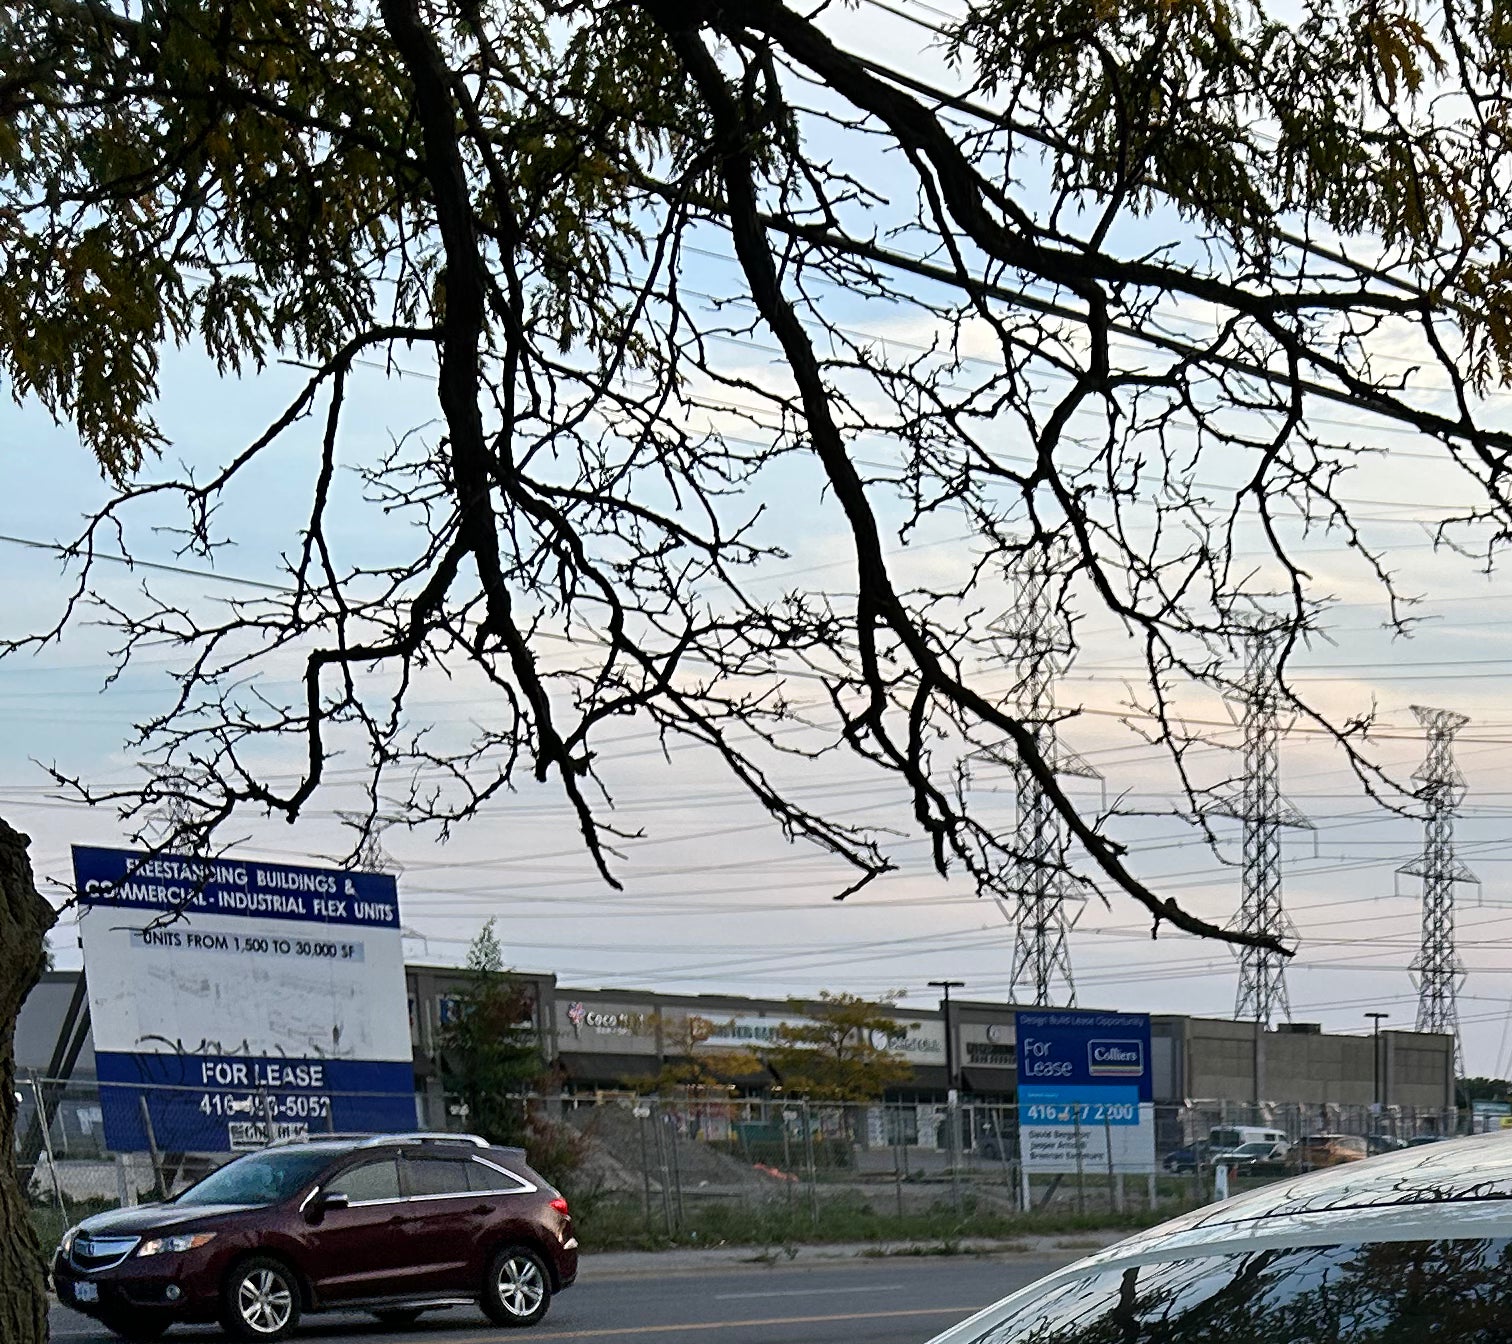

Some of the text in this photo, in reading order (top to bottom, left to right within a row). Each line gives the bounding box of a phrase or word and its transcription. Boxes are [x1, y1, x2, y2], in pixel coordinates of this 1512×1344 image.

[257, 868, 336, 894] BUILDINGS
[218, 891, 306, 915] INDUSTRIAL
[313, 899, 347, 918] FLEX
[354, 902, 394, 922] UNITS
[143, 930, 182, 947] UNITS
[187, 934, 228, 950] FROM
[234, 937, 269, 954] 1,500
[272, 940, 290, 955] TO
[295, 941, 338, 959] 30,000
[1024, 1037, 1052, 1057] For
[1094, 1047, 1138, 1061] Colliers
[201, 1062, 324, 1087] FOR LEASE
[1025, 1058, 1073, 1077] Lease
[1028, 1103, 1057, 1120] 416
